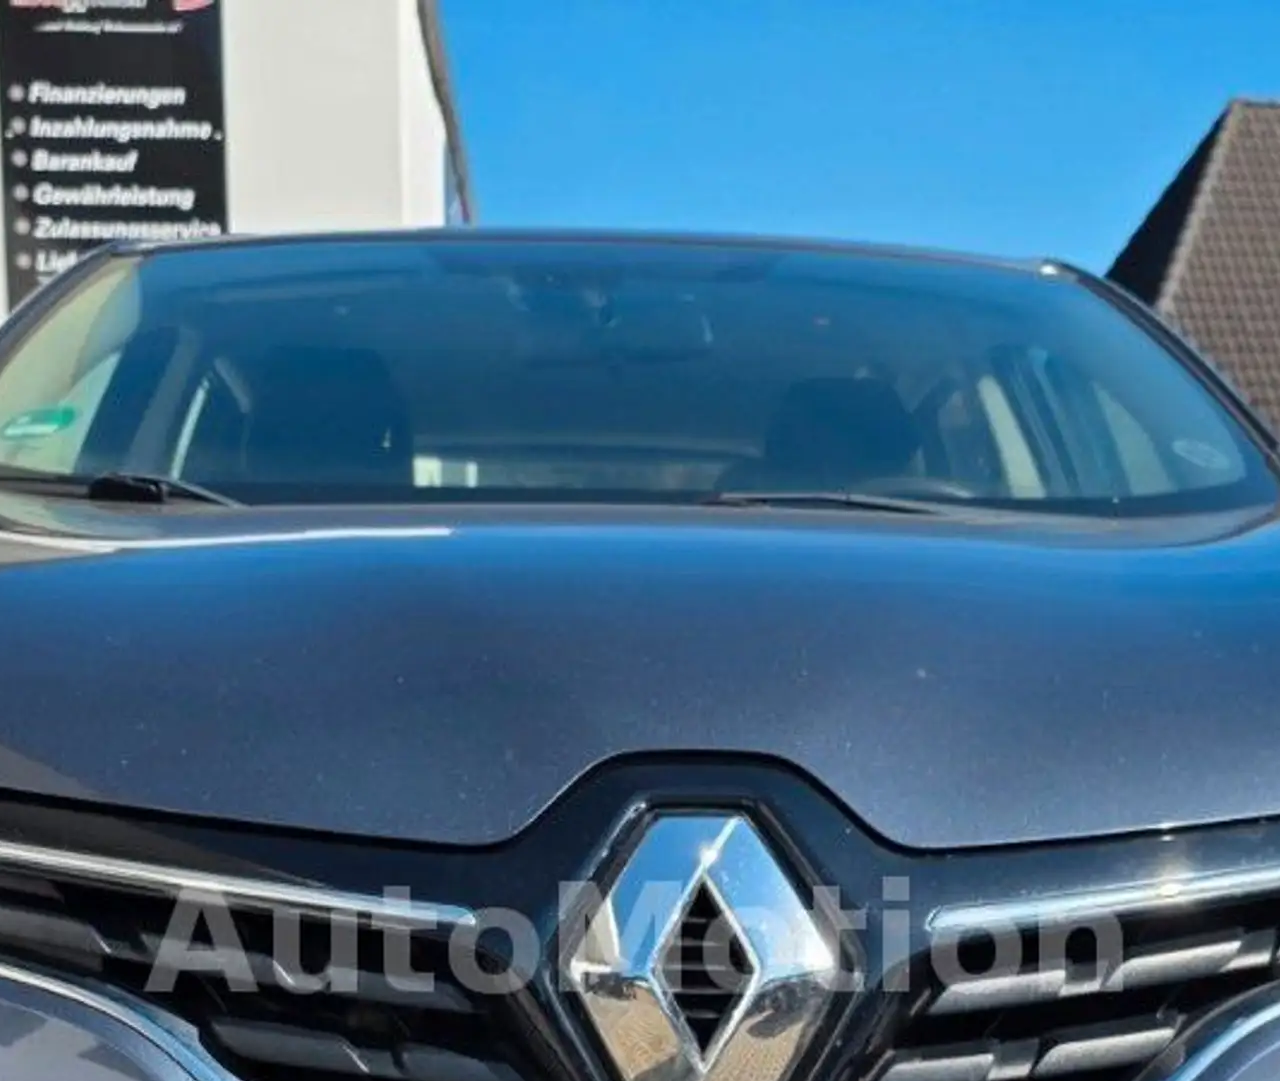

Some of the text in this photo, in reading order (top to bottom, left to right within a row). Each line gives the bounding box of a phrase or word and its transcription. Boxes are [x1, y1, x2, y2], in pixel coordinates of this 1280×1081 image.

[29, 81, 186, 108] Finanzierungen
[29, 117, 212, 142] Inzahlungsnahme
[31, 149, 138, 172] Barankauf
[33, 183, 195, 210] Gewährleistung
